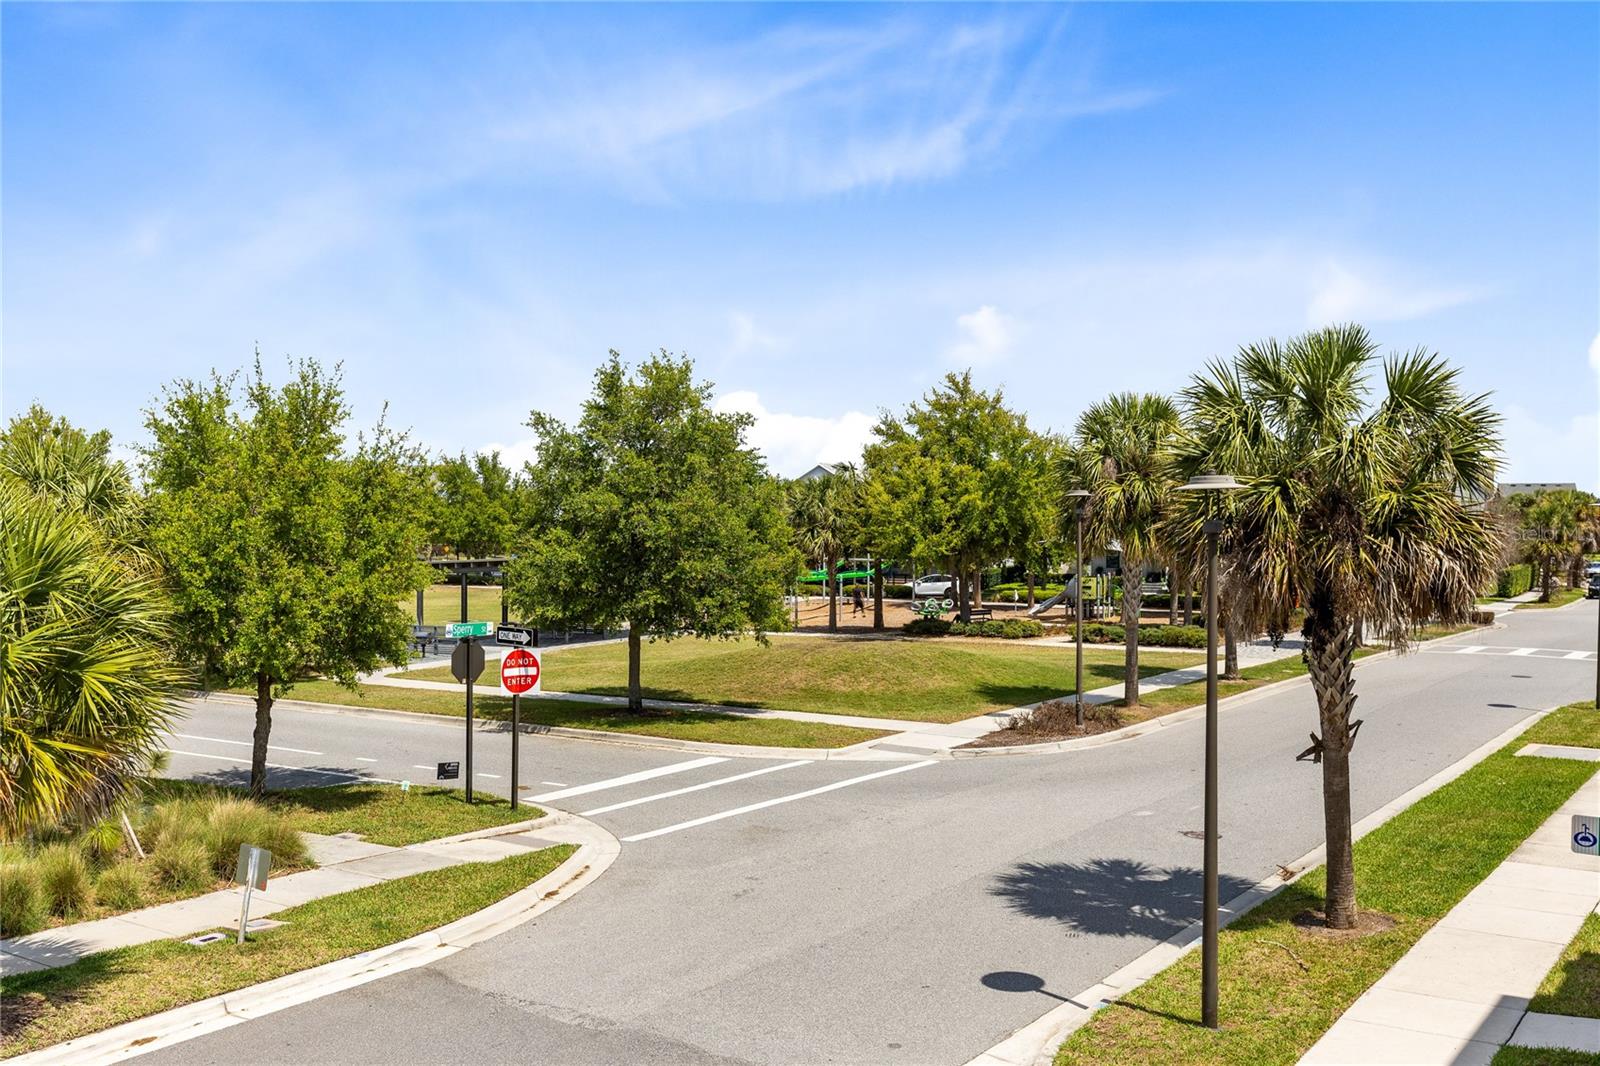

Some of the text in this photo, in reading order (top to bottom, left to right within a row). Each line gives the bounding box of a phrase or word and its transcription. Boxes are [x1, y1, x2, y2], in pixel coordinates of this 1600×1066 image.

[453, 625, 473, 636] Sperry
[500, 631, 523, 641] ONE WAY
[518, 657, 534, 665] NOT
[507, 677, 532, 685] ENTER
